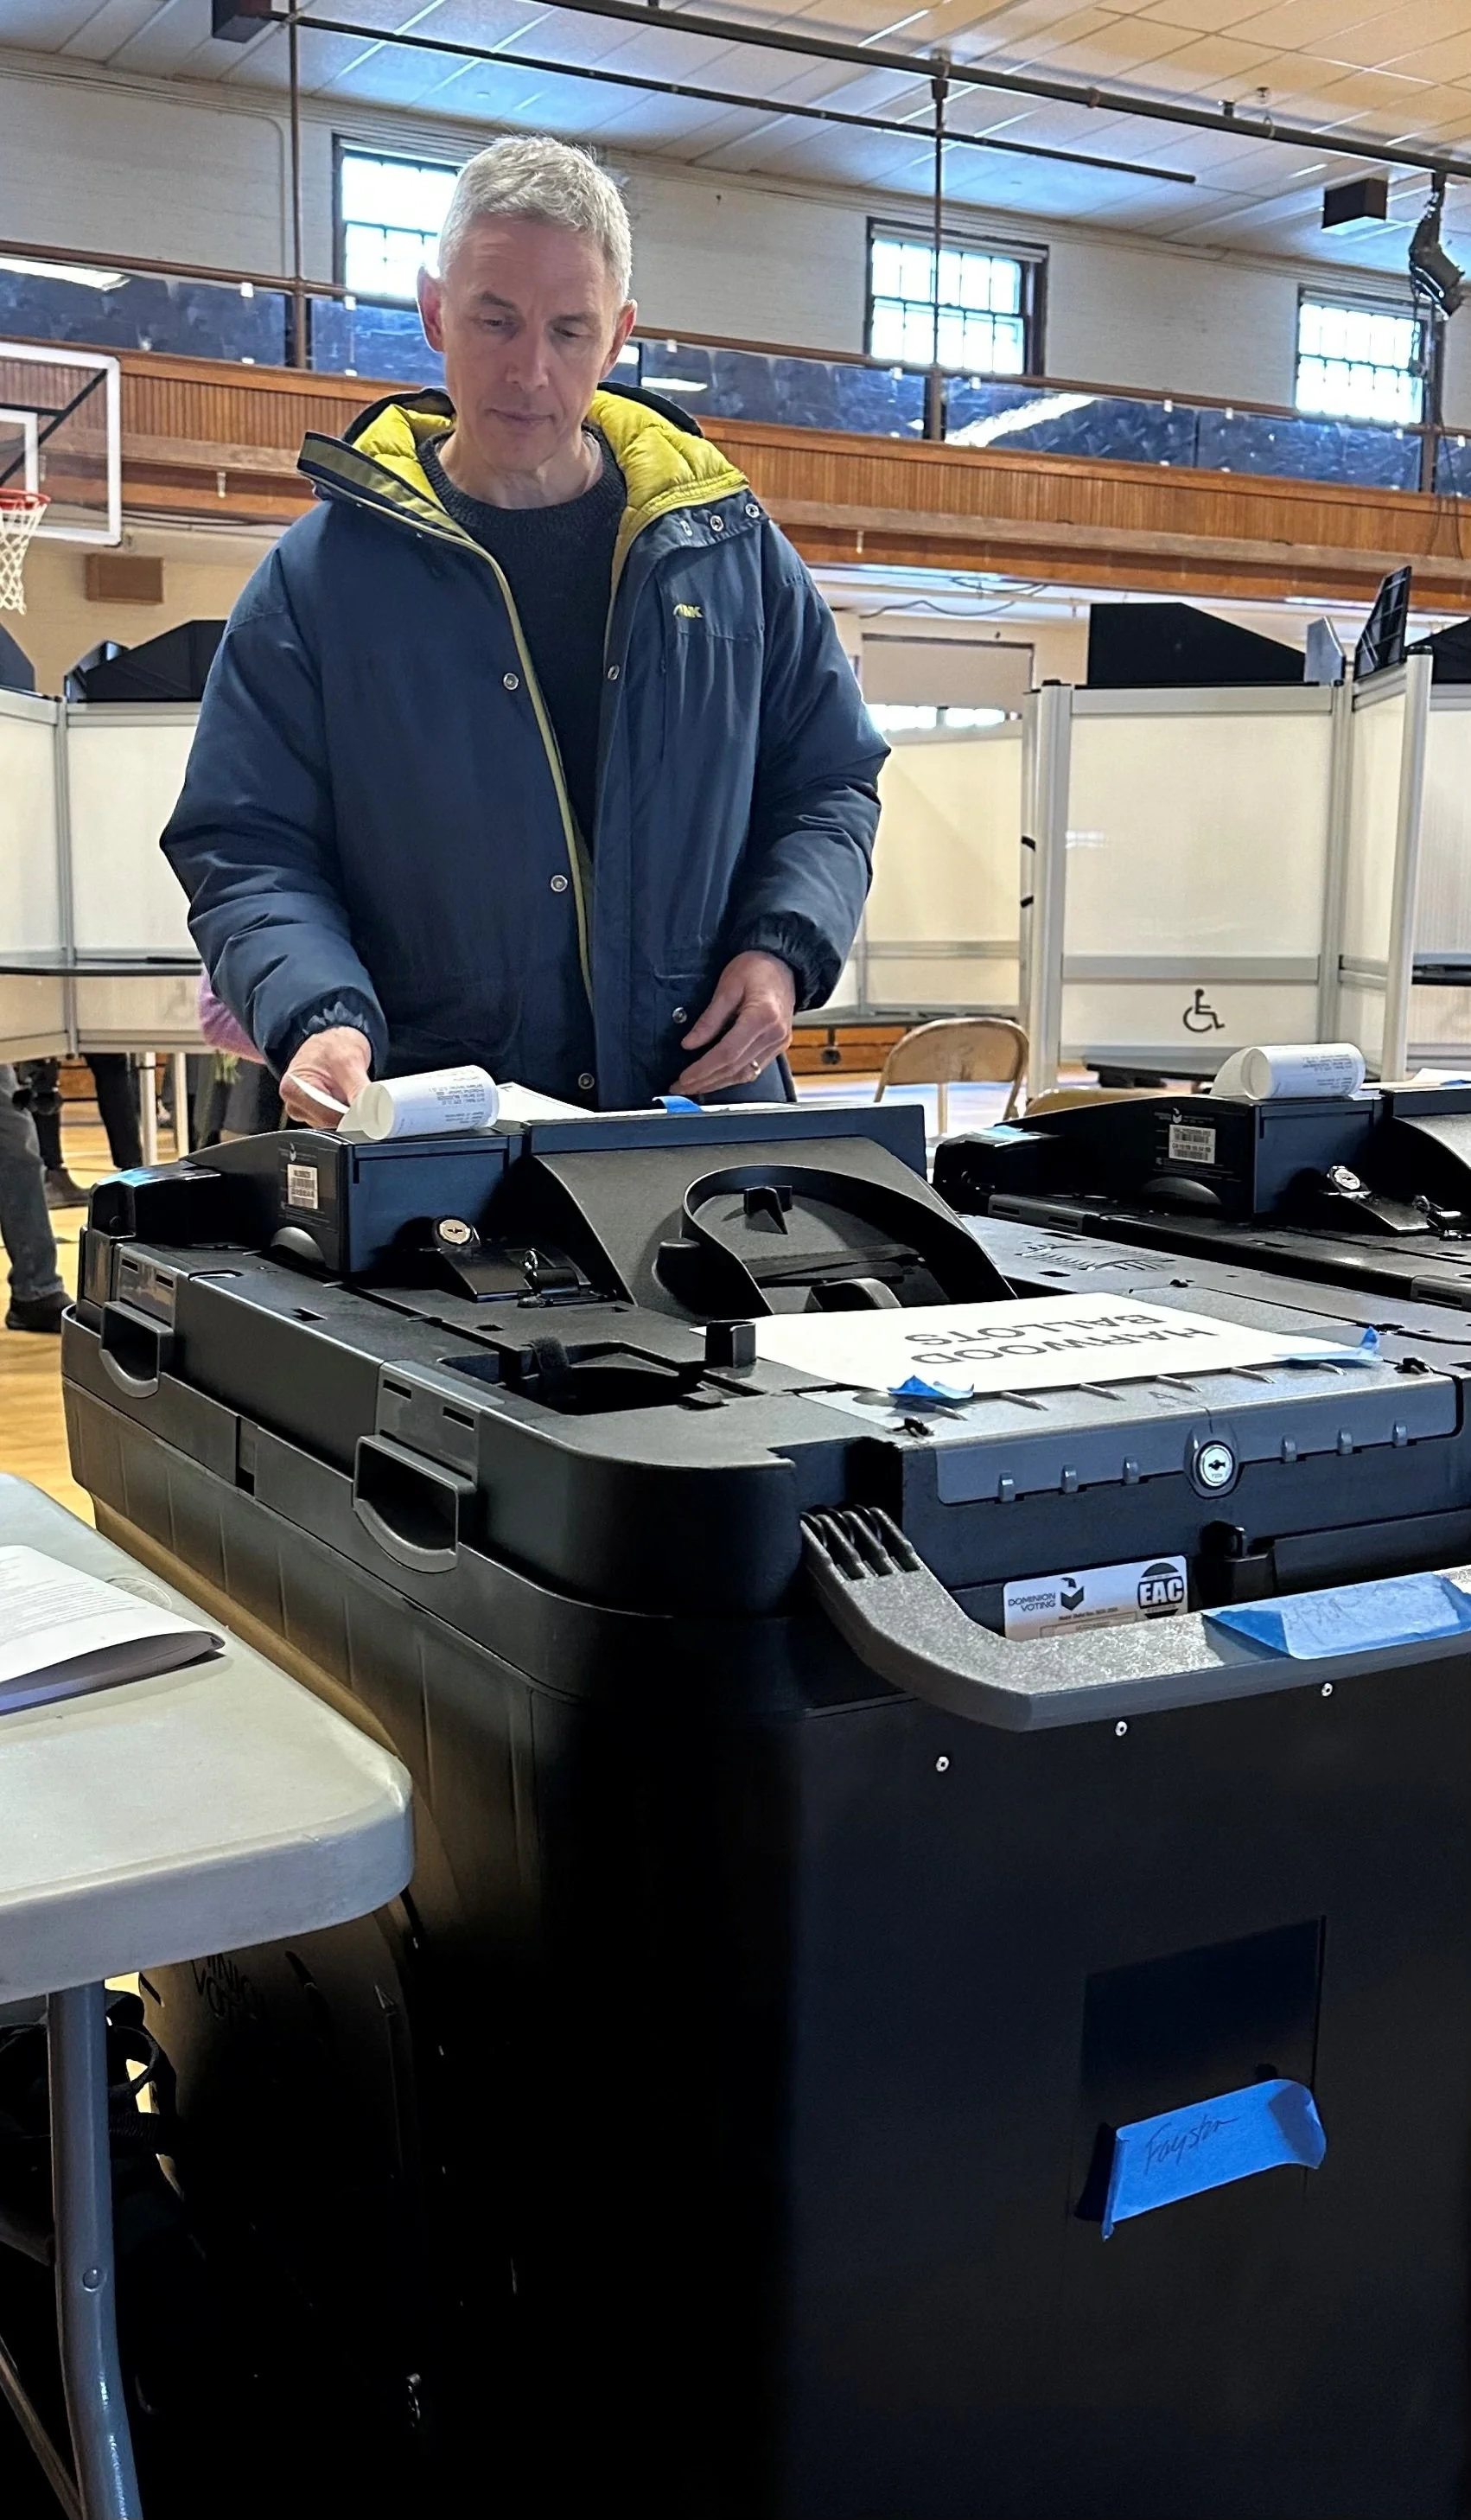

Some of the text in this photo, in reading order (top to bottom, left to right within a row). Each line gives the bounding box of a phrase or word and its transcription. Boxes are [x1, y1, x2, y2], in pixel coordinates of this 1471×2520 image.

[904, 1314, 1167, 1345] BALLOTS
[911, 1328, 1219, 1364] HARWOOD
[1008, 1592, 1056, 1606] DOMINION
[1021, 1599, 1056, 1612] VOTING
[1139, 1578, 1183, 1607] EAC
